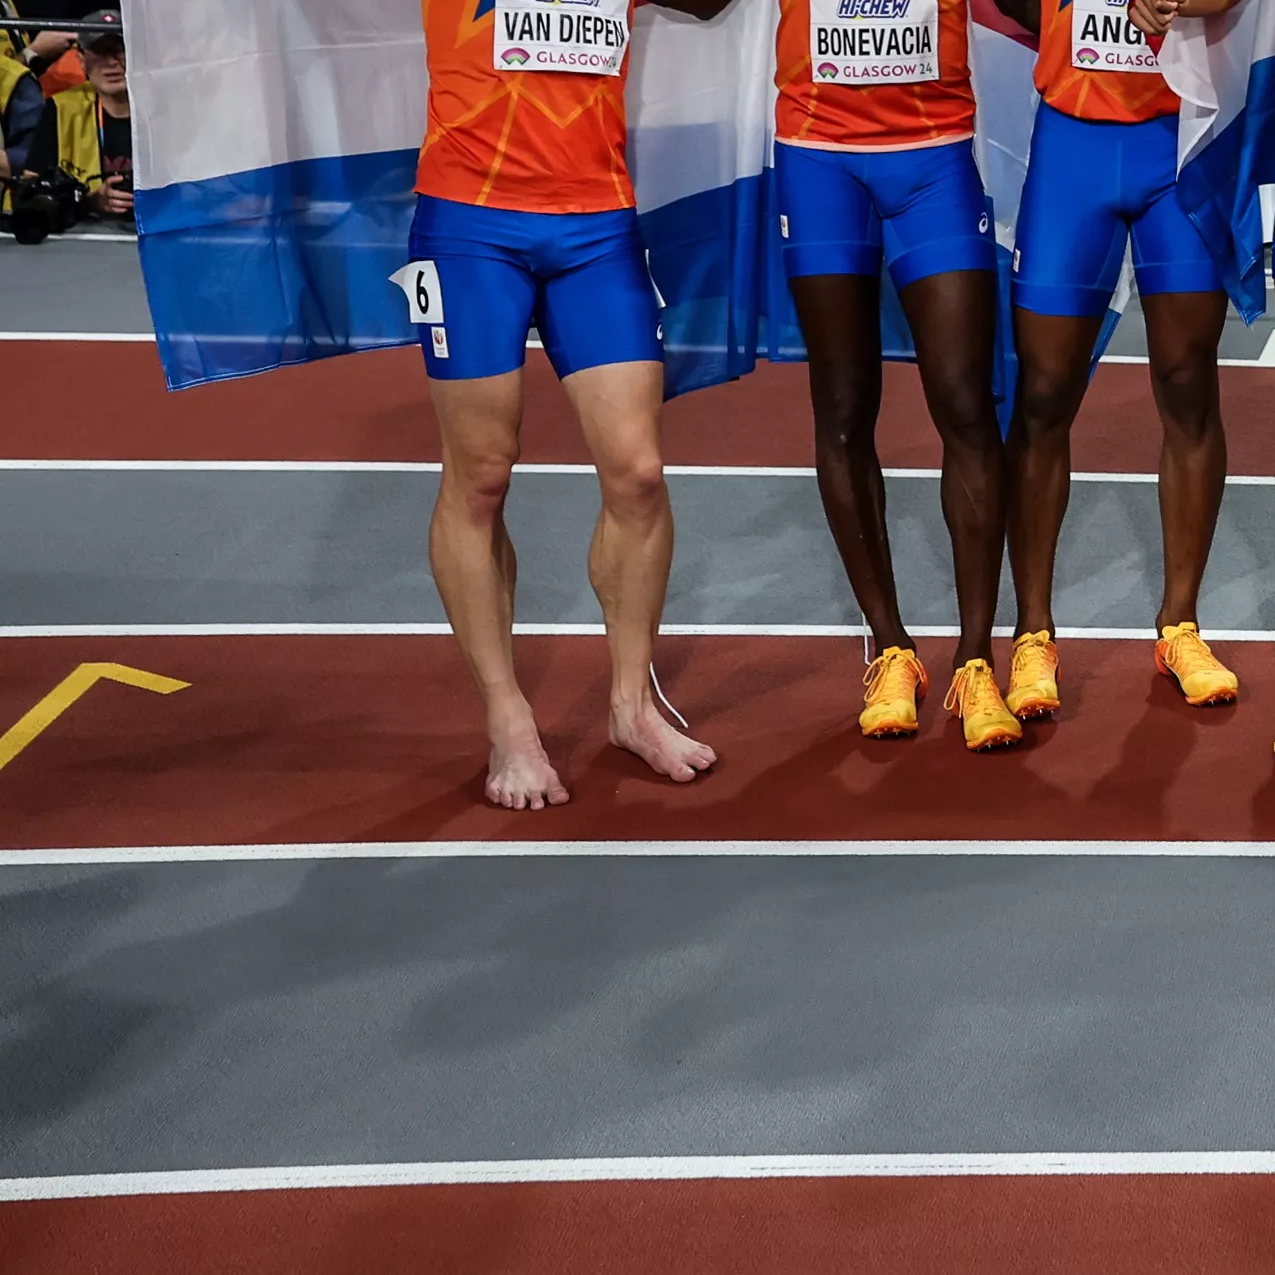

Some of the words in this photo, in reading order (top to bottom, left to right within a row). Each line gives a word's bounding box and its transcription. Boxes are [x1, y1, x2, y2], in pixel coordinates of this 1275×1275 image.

[504, 12, 550, 42] VAN
[559, 14, 625, 48] DIEPEN
[817, 25, 932, 56] BONEVACIA
[1080, 14, 1149, 46] ANG
[536, 51, 611, 67] GLASGOW
[843, 63, 917, 78] GLASGOW
[919, 62, 933, 75] 24
[416, 270, 429, 314] 6
